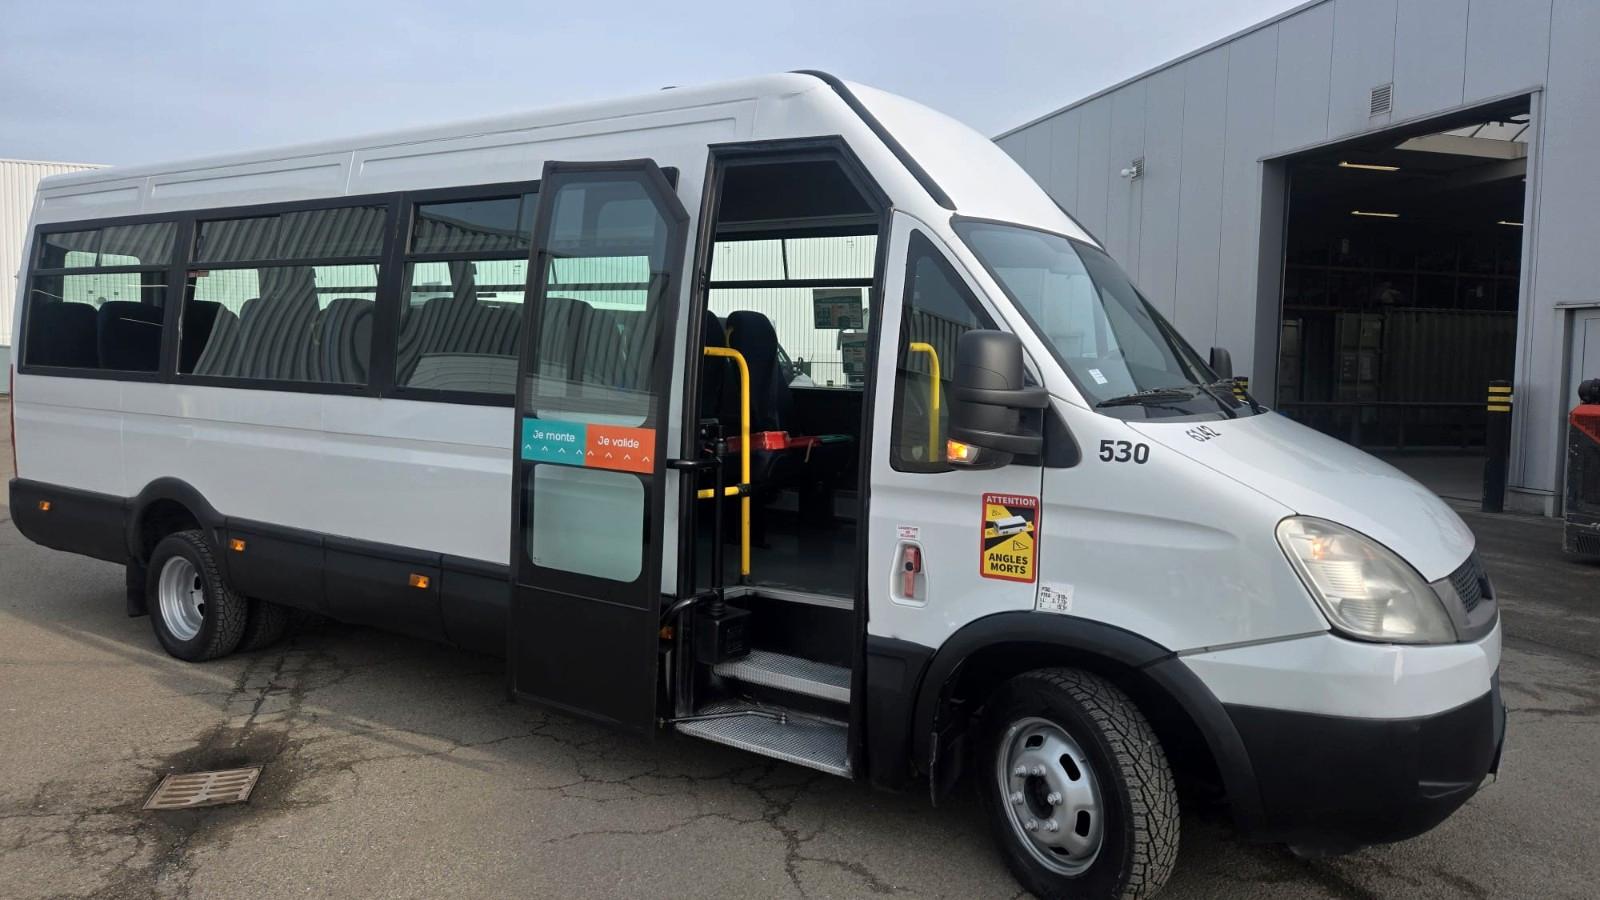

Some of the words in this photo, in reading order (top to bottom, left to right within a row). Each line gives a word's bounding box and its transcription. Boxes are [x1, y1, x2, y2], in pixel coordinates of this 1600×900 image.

[533, 430, 544, 439] Je
[546, 431, 576, 442] monte
[1185, 425, 1222, 442] 6142
[598, 436, 610, 446] Je
[612, 437, 640, 449] valide
[1099, 439, 1150, 465] 530
[986, 495, 1036, 506] ATTENTION
[988, 552, 1028, 565] ANGLES
[990, 563, 1026, 575] MORTS
